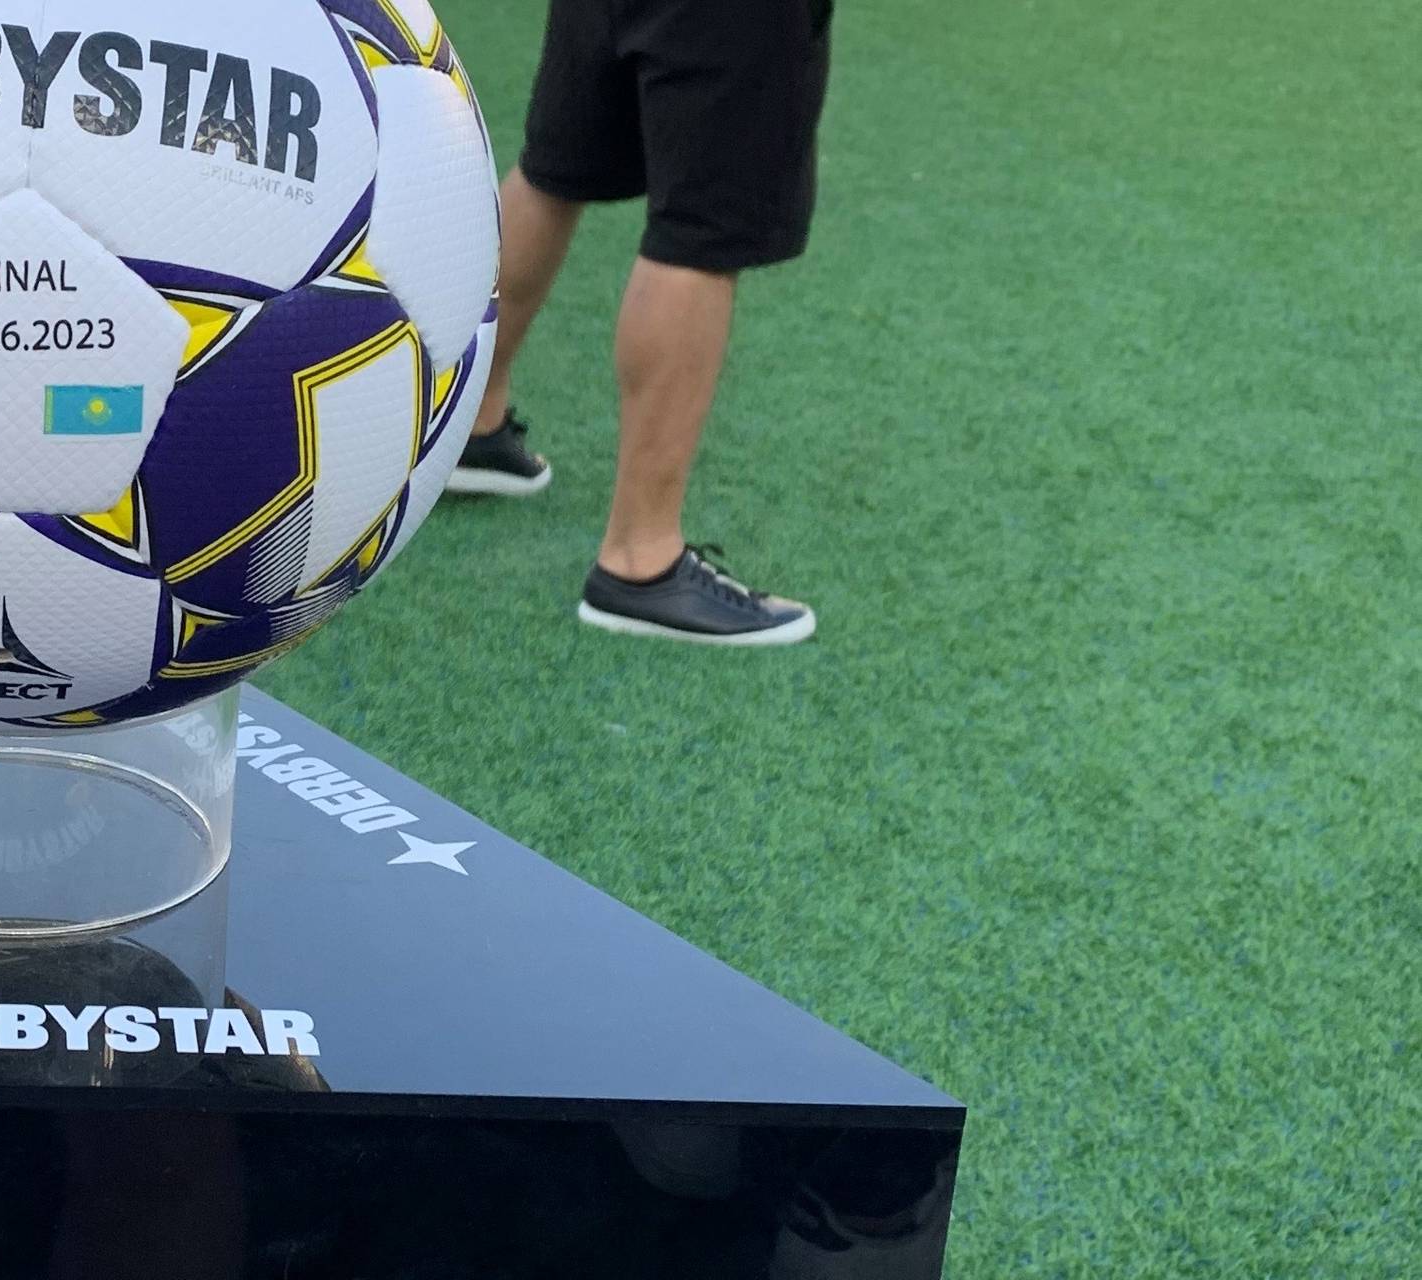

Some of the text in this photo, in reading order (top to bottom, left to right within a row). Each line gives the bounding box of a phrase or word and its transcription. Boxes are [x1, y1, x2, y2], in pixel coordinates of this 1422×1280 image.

[200, 161, 315, 205] BRILLANT APS
[236, 710, 421, 834] DERBYS
